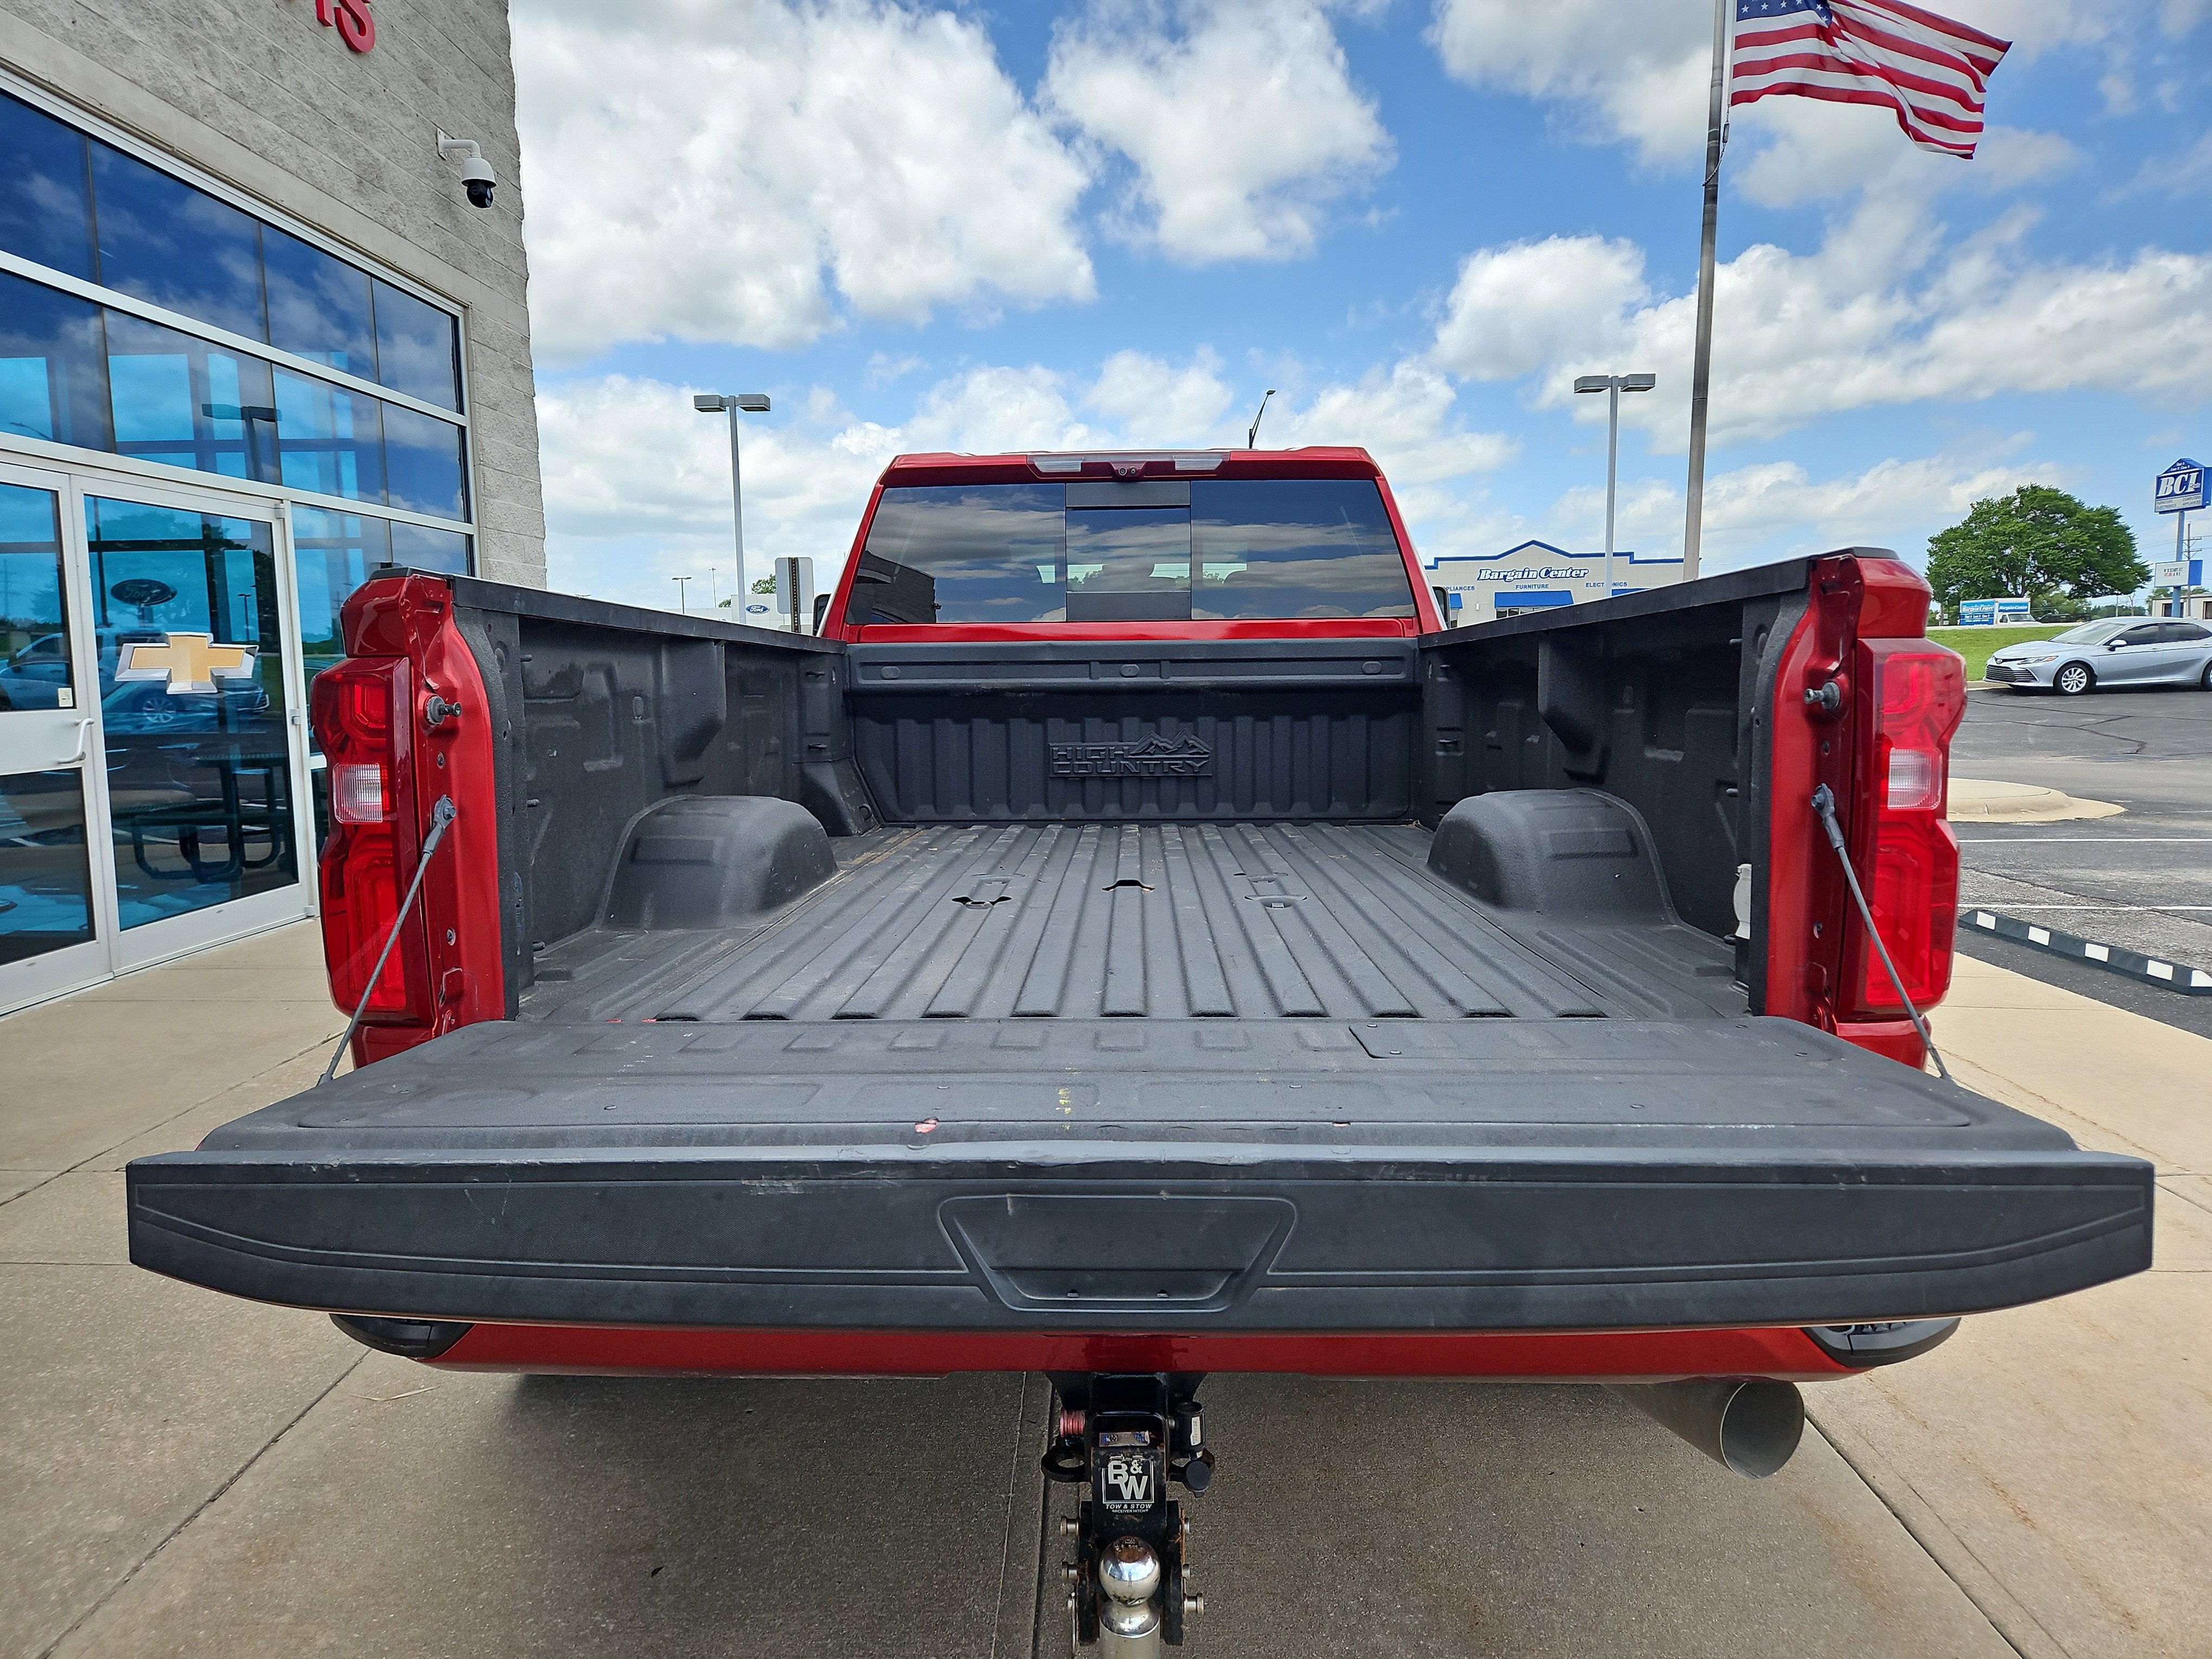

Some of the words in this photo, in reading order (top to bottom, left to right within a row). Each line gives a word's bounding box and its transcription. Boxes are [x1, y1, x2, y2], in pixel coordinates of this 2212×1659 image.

[2156, 472, 2199, 497] BCI
[1477, 567, 1538, 582] Bargain
[1539, 567, 1589, 580] Center
[1052, 746, 1129, 759] HIGH
[1053, 760, 1209, 774] COUNTRY
